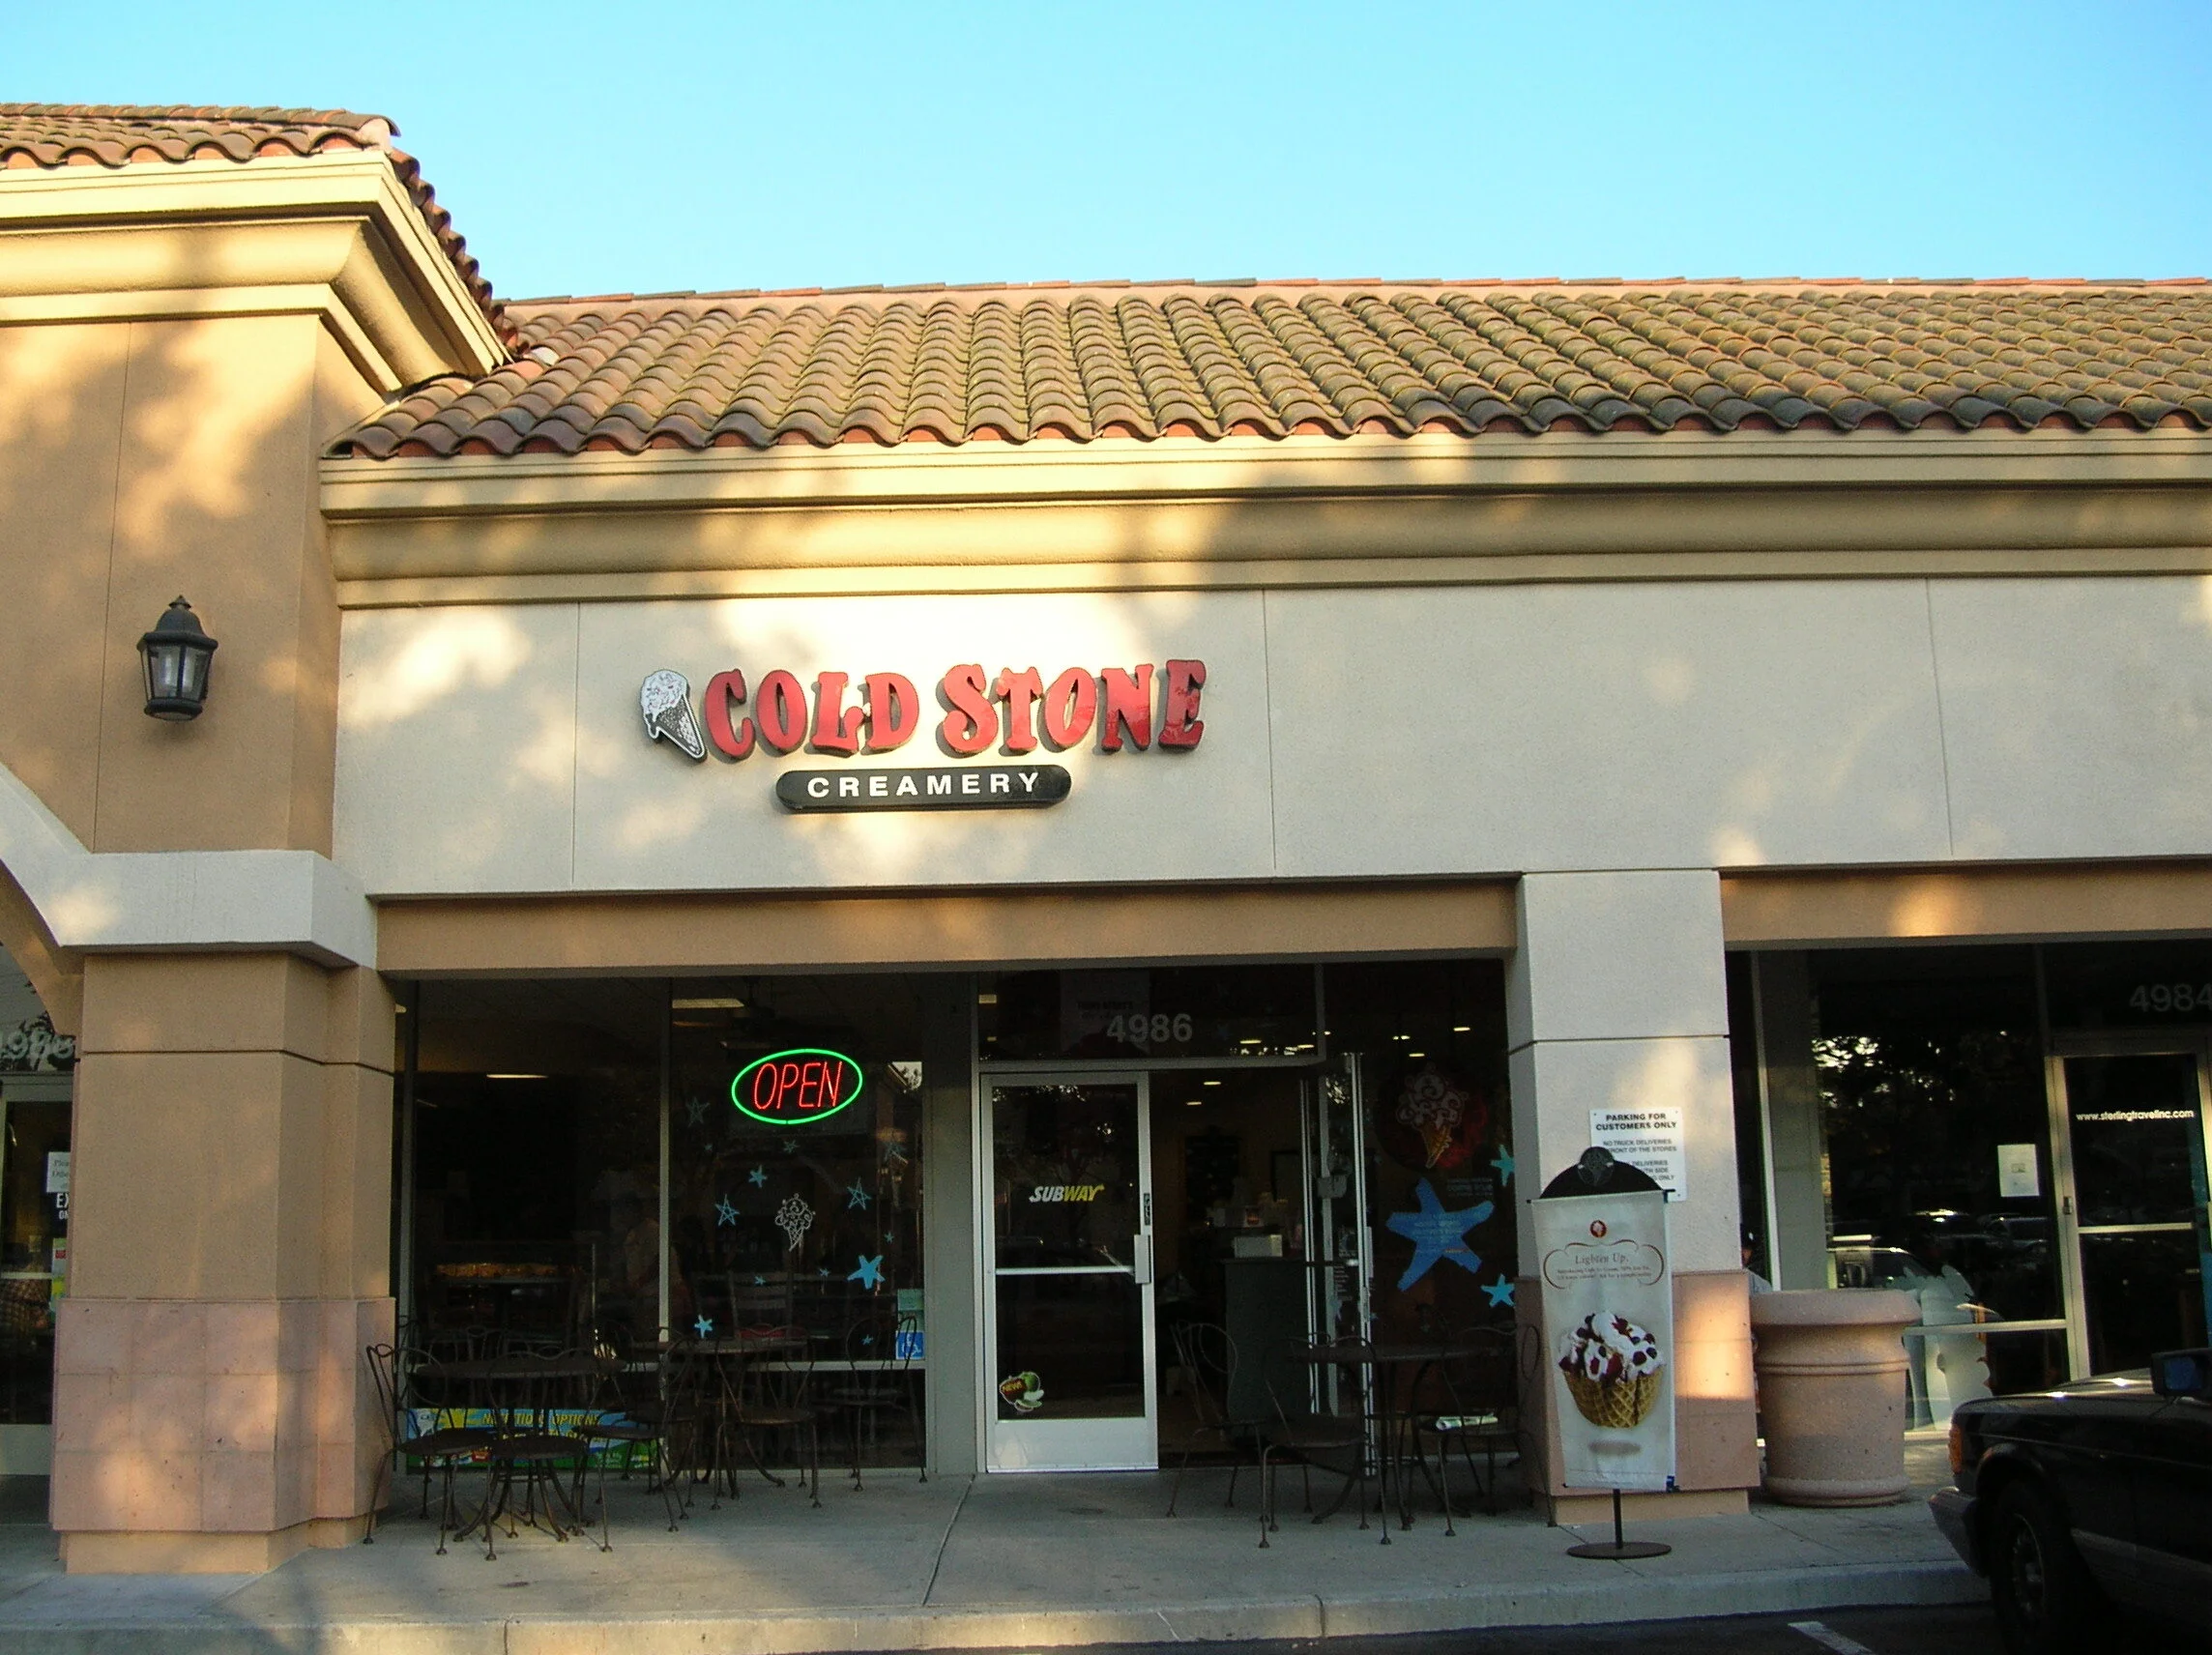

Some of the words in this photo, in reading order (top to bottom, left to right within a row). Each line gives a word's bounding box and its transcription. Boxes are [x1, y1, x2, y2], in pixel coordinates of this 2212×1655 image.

[705, 667, 919, 759] COLD
[943, 658, 1208, 756] STONE
[806, 771, 1040, 798] CREAMERY
[1106, 1013, 1193, 1043] 4986
[753, 1060, 844, 1111] OPEN
[1595, 1122, 1651, 1132] CUSTOMERS
[1653, 1121, 1677, 1130] ONLY
[1606, 1113, 1646, 1122] PARKING
[1648, 1113, 1667, 1121] FOR
[1028, 1184, 1105, 1204] SUBWAY
